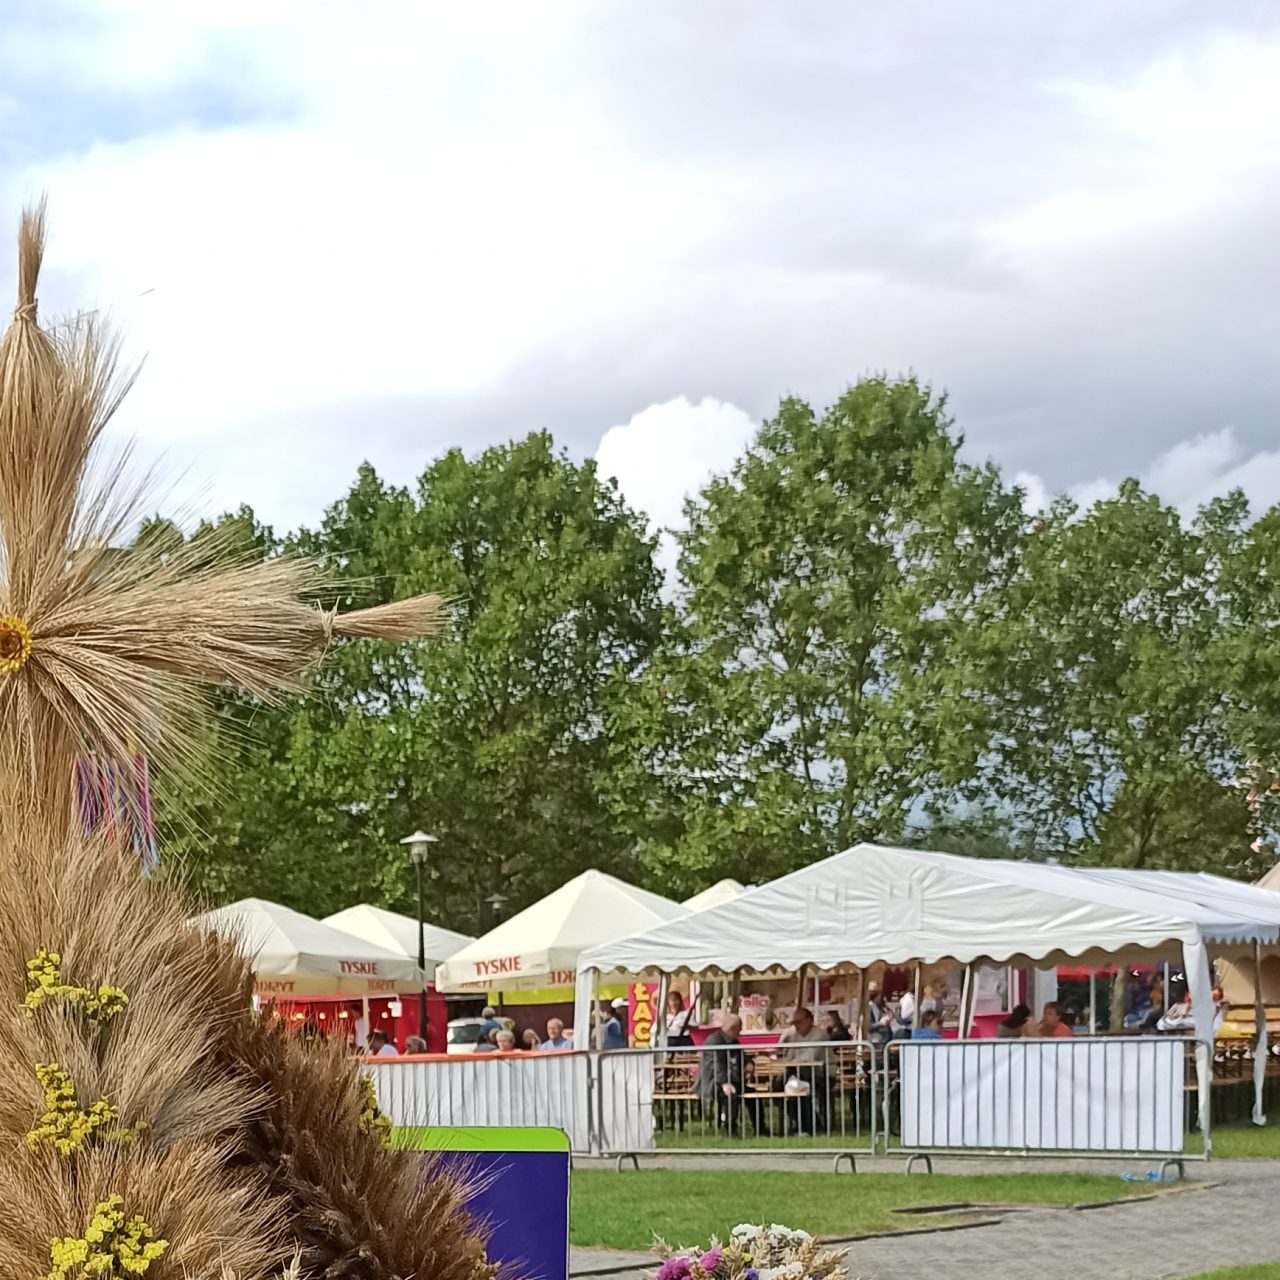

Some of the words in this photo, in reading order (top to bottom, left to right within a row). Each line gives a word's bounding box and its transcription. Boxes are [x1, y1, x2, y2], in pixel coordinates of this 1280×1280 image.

[339, 961, 378, 975] TYSKIE
[476, 956, 522, 976] TYSKIE
[633, 983, 652, 1048] ŁAC
